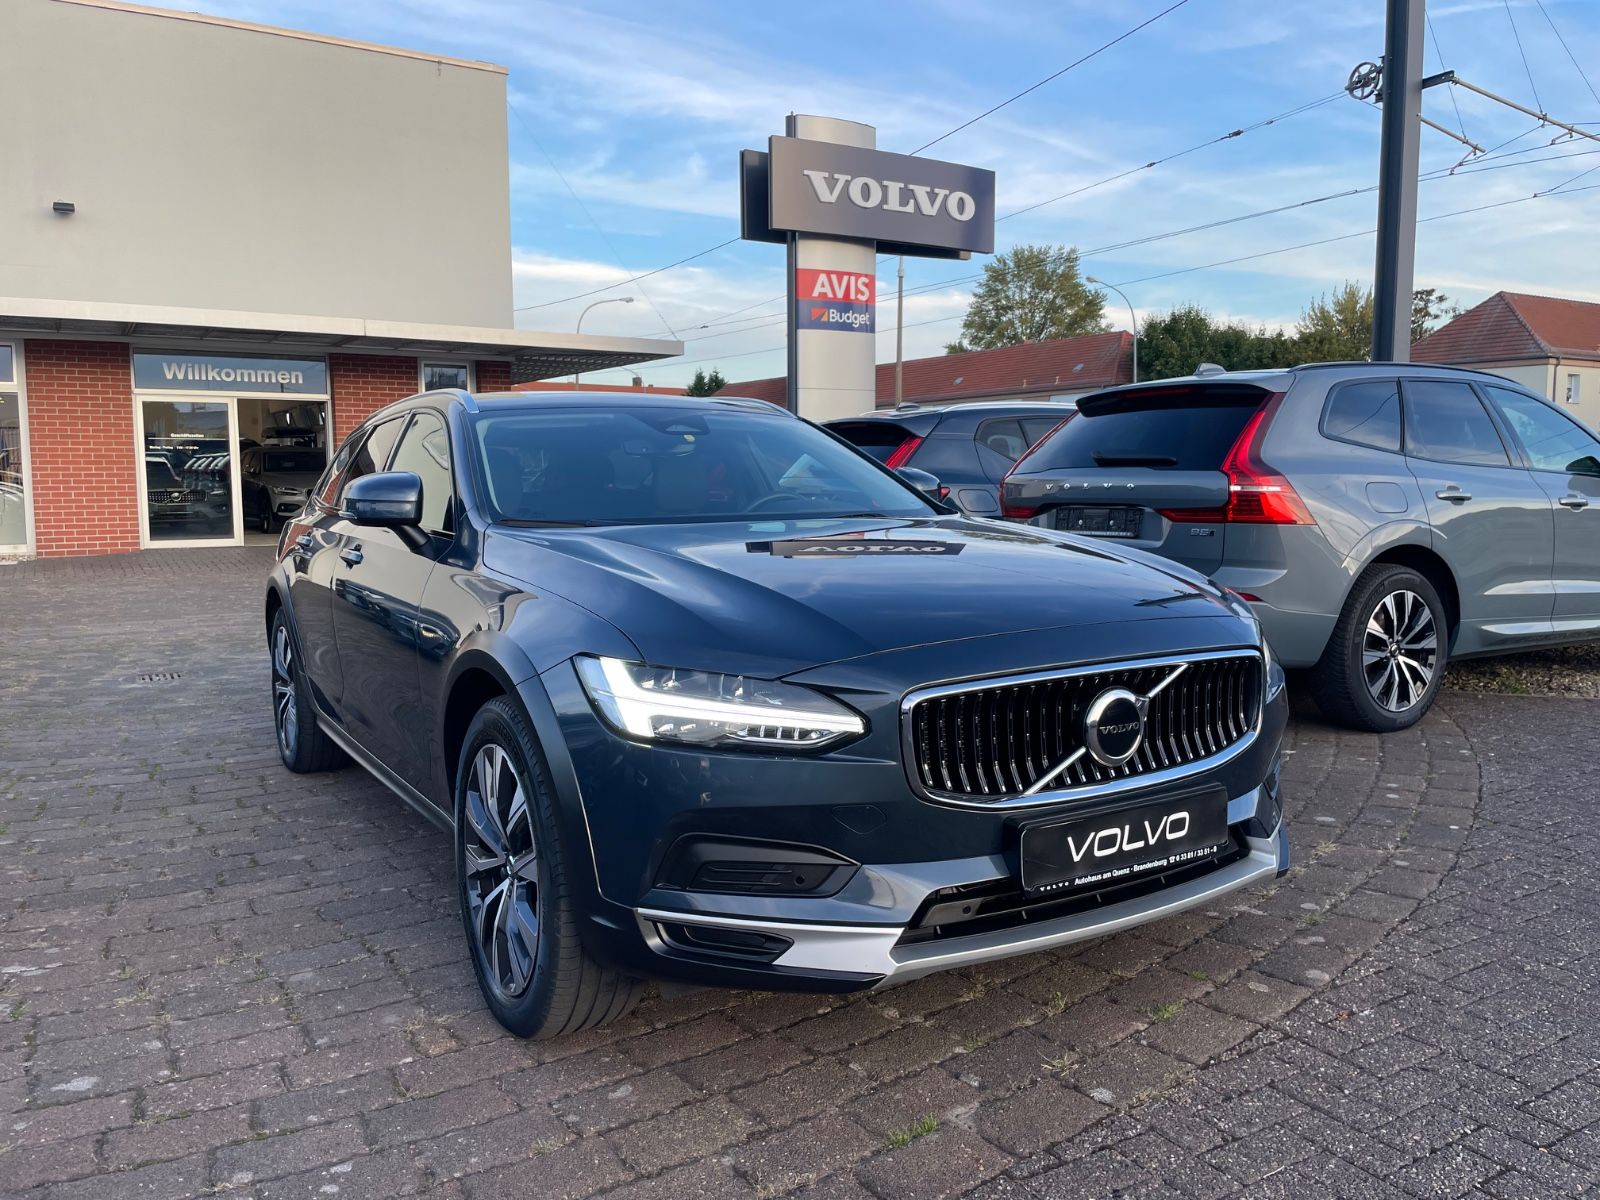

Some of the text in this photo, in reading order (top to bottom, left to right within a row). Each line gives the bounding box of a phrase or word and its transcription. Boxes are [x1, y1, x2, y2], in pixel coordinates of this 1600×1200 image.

[803, 169, 976, 222] VOLVO
[812, 273, 870, 301] AVIS
[829, 308, 870, 328] Budget
[162, 362, 304, 384] Willkommen
[1045, 482, 1135, 490] VOLVO
[1099, 721, 1140, 735] VOLVO
[1067, 811, 1190, 862] VOLVO
[1074, 874, 1102, 885] Autohaus
[1112, 867, 1130, 877] Quenz
[1133, 858, 1168, 872] Brandenburg
